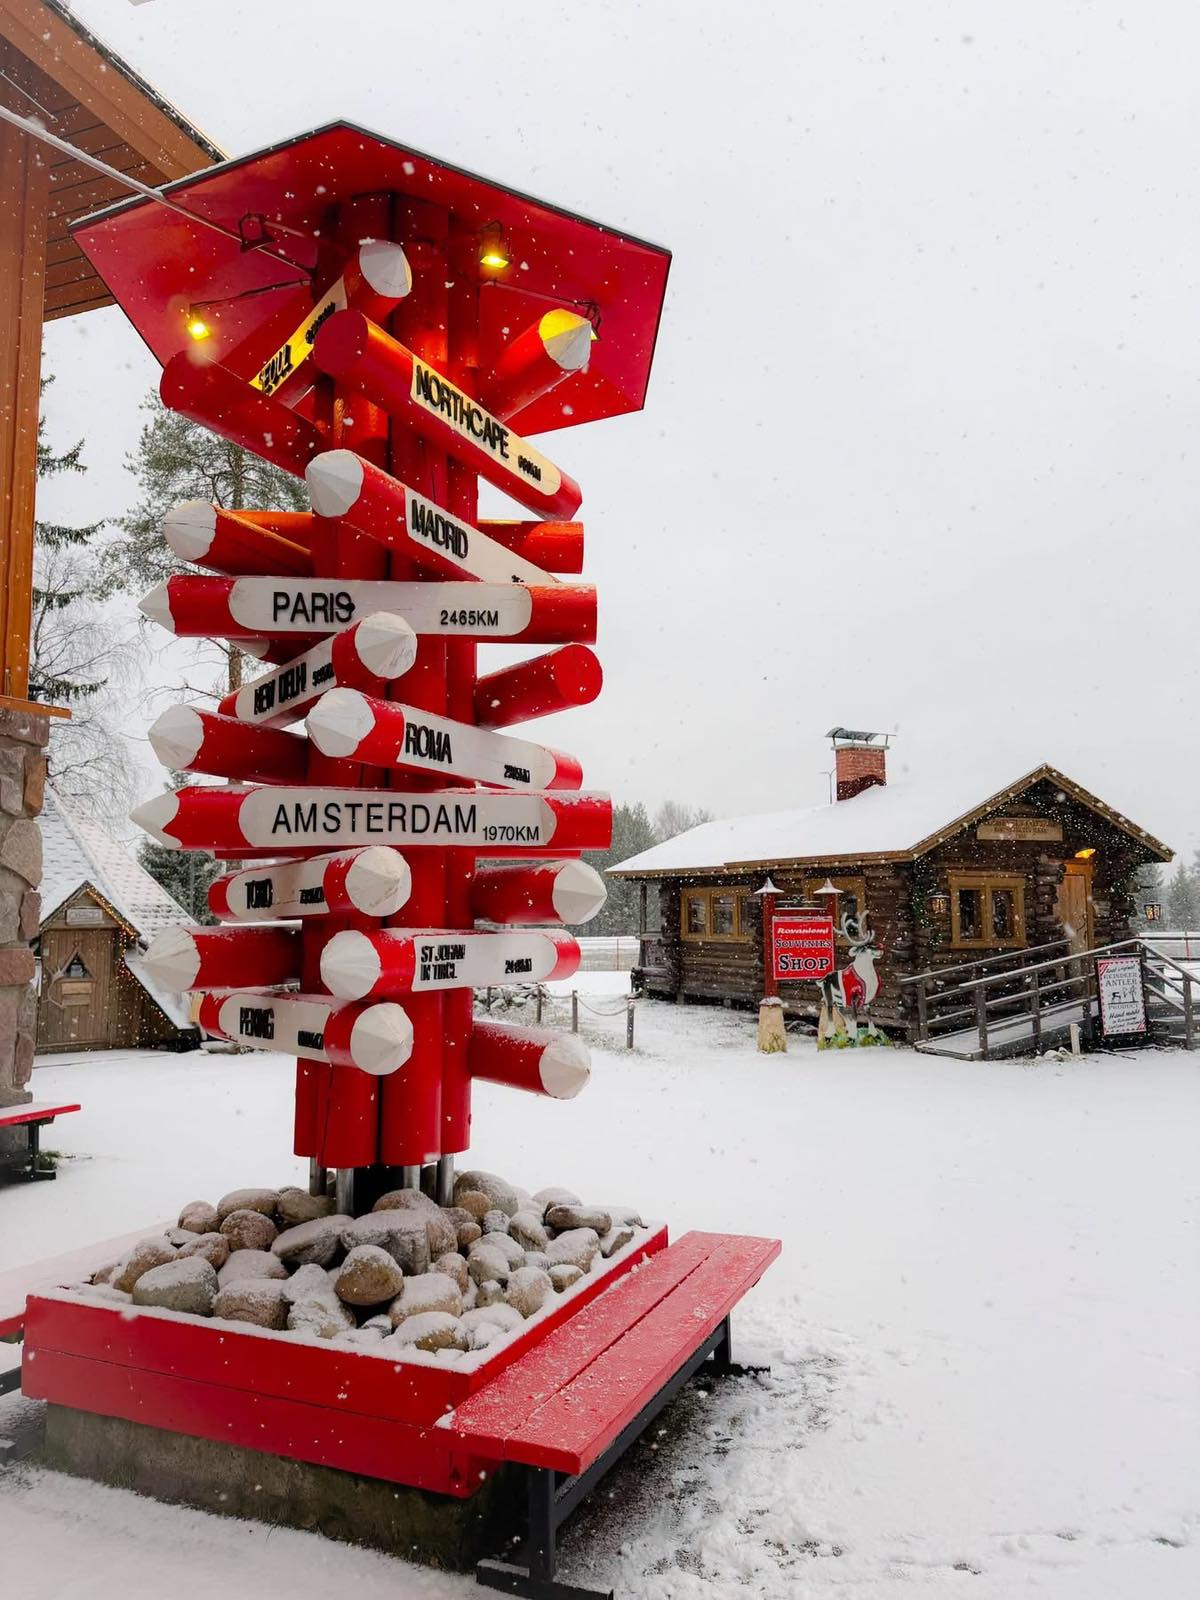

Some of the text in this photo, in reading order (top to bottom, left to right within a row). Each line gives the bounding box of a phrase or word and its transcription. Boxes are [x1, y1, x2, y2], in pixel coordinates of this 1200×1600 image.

[416, 364, 510, 459] NORTHCAPE
[411, 499, 469, 559] MADRID
[273, 591, 499, 626] PARIS 2465KM
[405, 722, 453, 764] ROMA
[271, 802, 540, 842] AMSTERDAM 1970KM
[777, 927, 829, 935] Rovaniemi
[420, 945, 435, 963] ST
